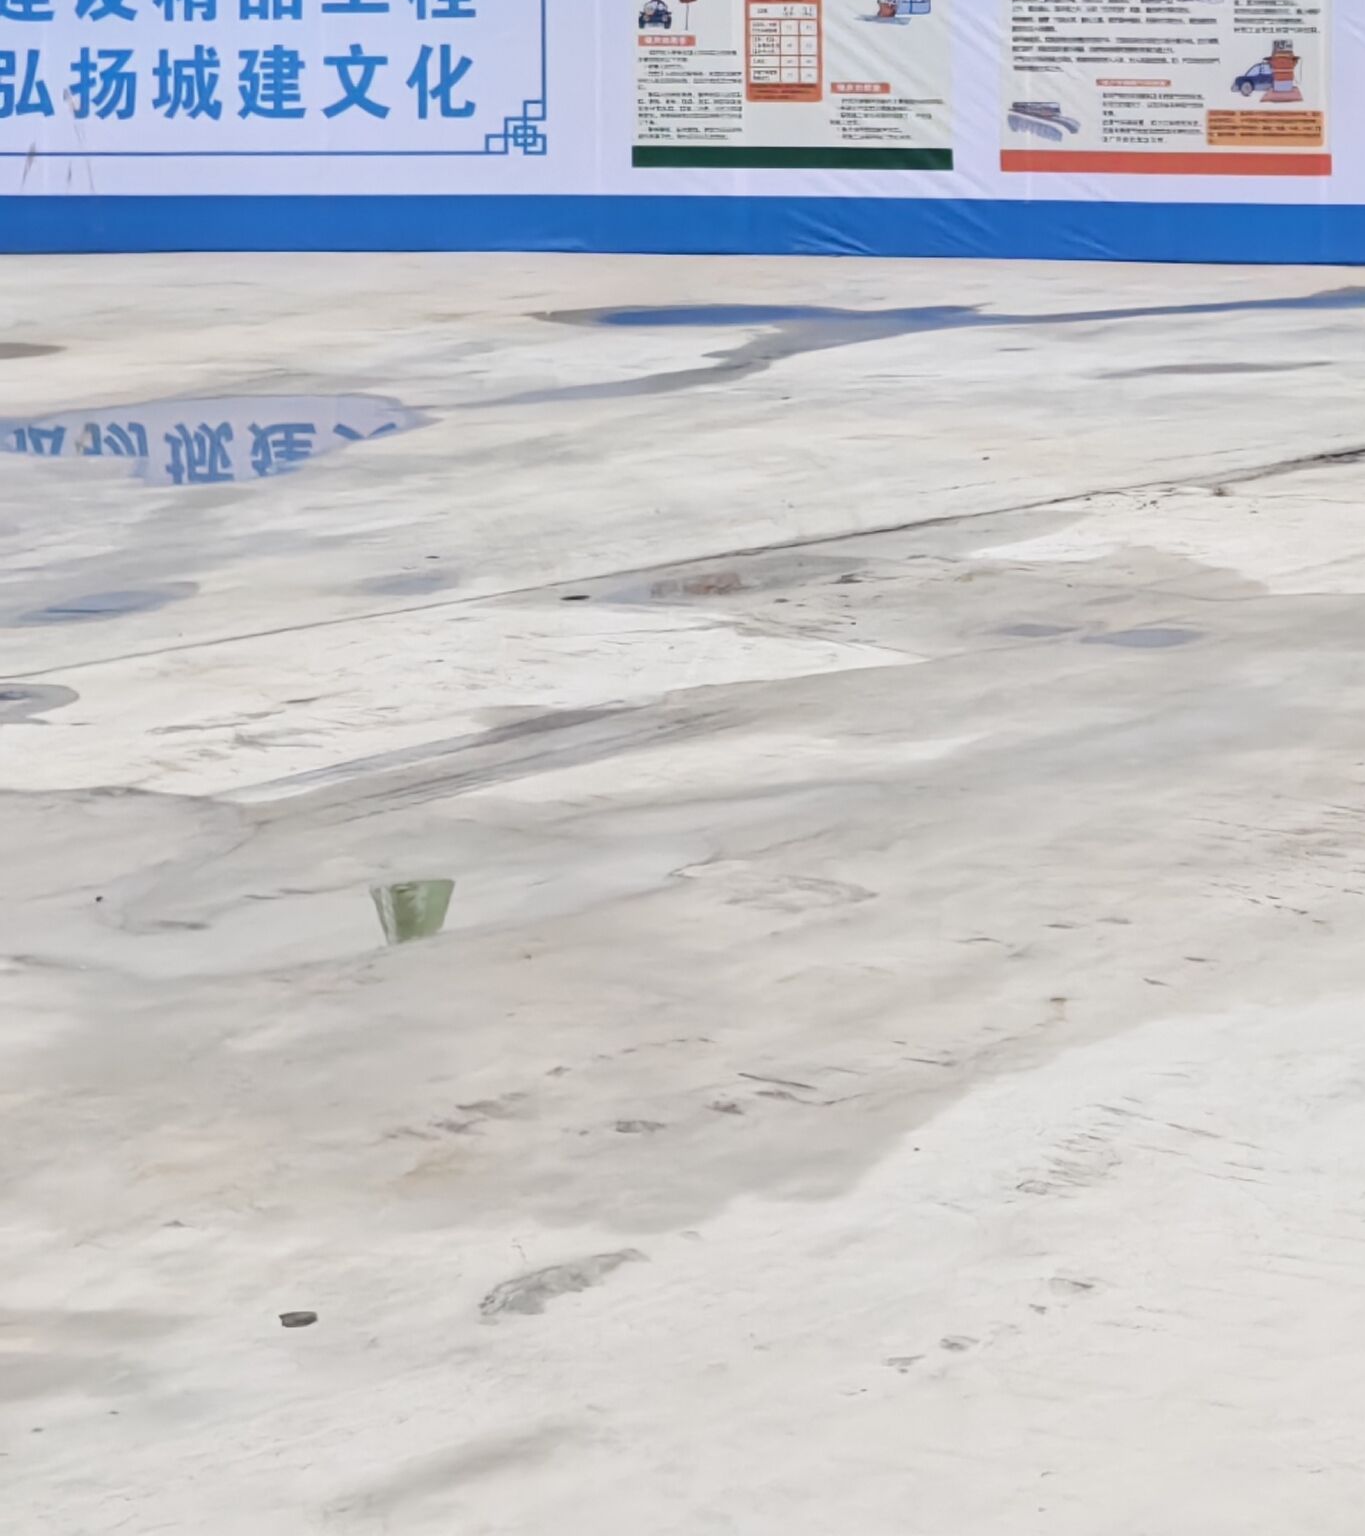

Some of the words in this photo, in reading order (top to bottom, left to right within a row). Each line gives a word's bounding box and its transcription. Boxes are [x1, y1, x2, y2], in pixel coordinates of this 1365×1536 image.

[0, 44, 476, 120] 弘扬城建文化
